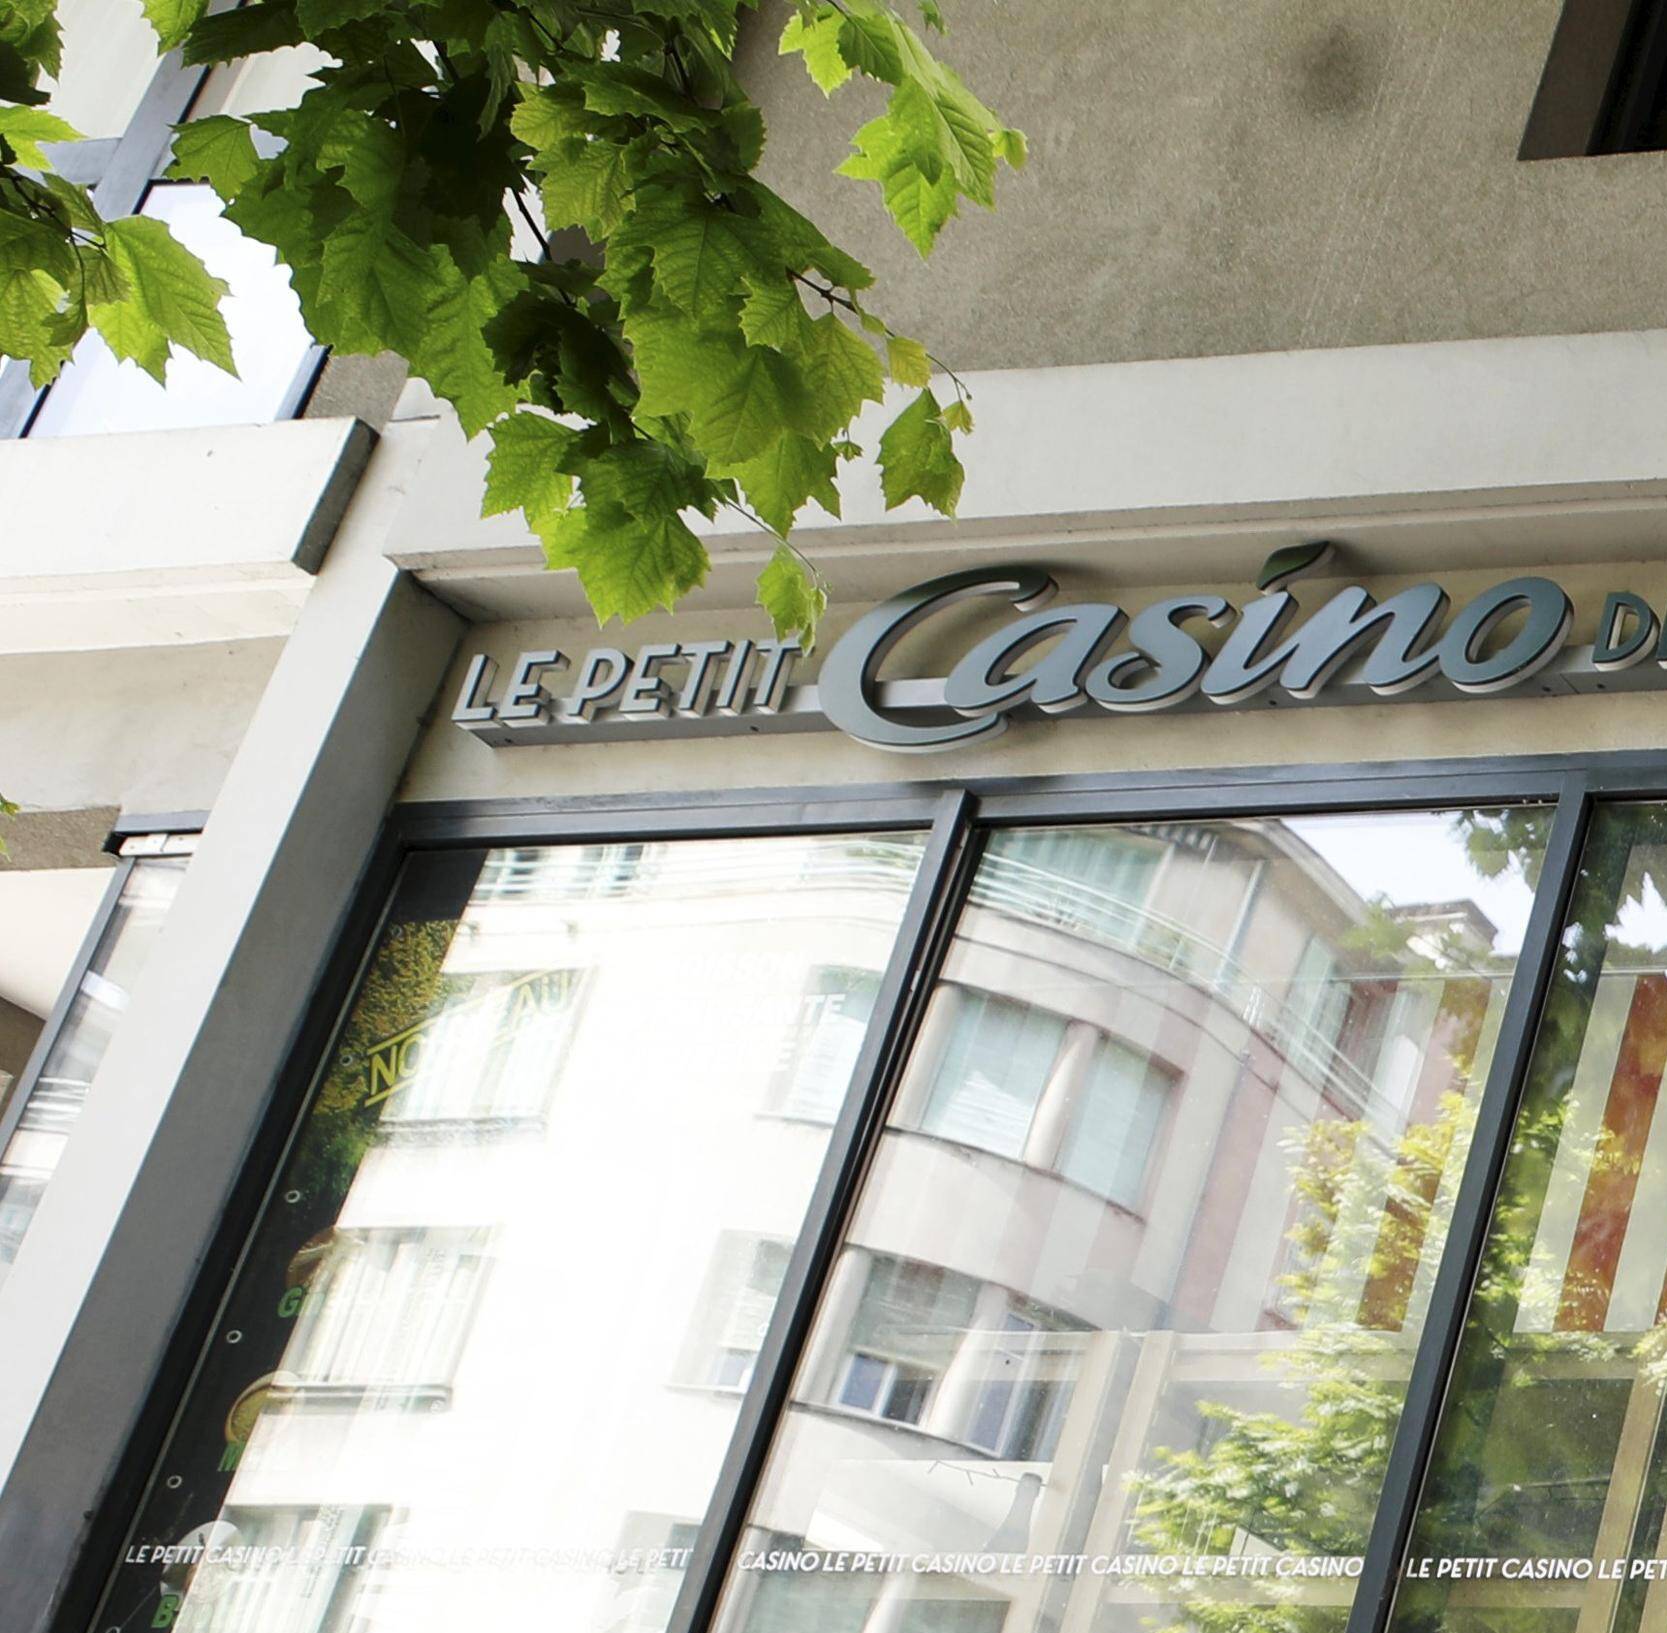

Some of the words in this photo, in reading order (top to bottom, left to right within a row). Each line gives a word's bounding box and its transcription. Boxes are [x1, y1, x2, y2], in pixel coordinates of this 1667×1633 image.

[451, 648, 568, 729] LE
[566, 639, 802, 725] PETIT
[819, 540, 1576, 755] Casino
[126, 1546, 149, 1563] LE
[151, 1546, 204, 1564] PETIT
[740, 1551, 820, 1572] CASINO
[822, 1553, 849, 1572] LE
[850, 1553, 912, 1573] PETIT
[913, 1553, 997, 1574] CASINO
[1000, 1554, 1027, 1574] LE
[1029, 1554, 1088, 1575] PETIT
[1091, 1555, 1177, 1576] CASINO
[1181, 1556, 1211, 1576] LE
[1211, 1556, 1271, 1577] PETIT
[1275, 1556, 1365, 1578] CASINO
[1406, 1558, 1433, 1578] LE
[1436, 1558, 1499, 1579] PETIT
[1501, 1558, 1593, 1580] CASINO
[1597, 1559, 1627, 1579] LE
